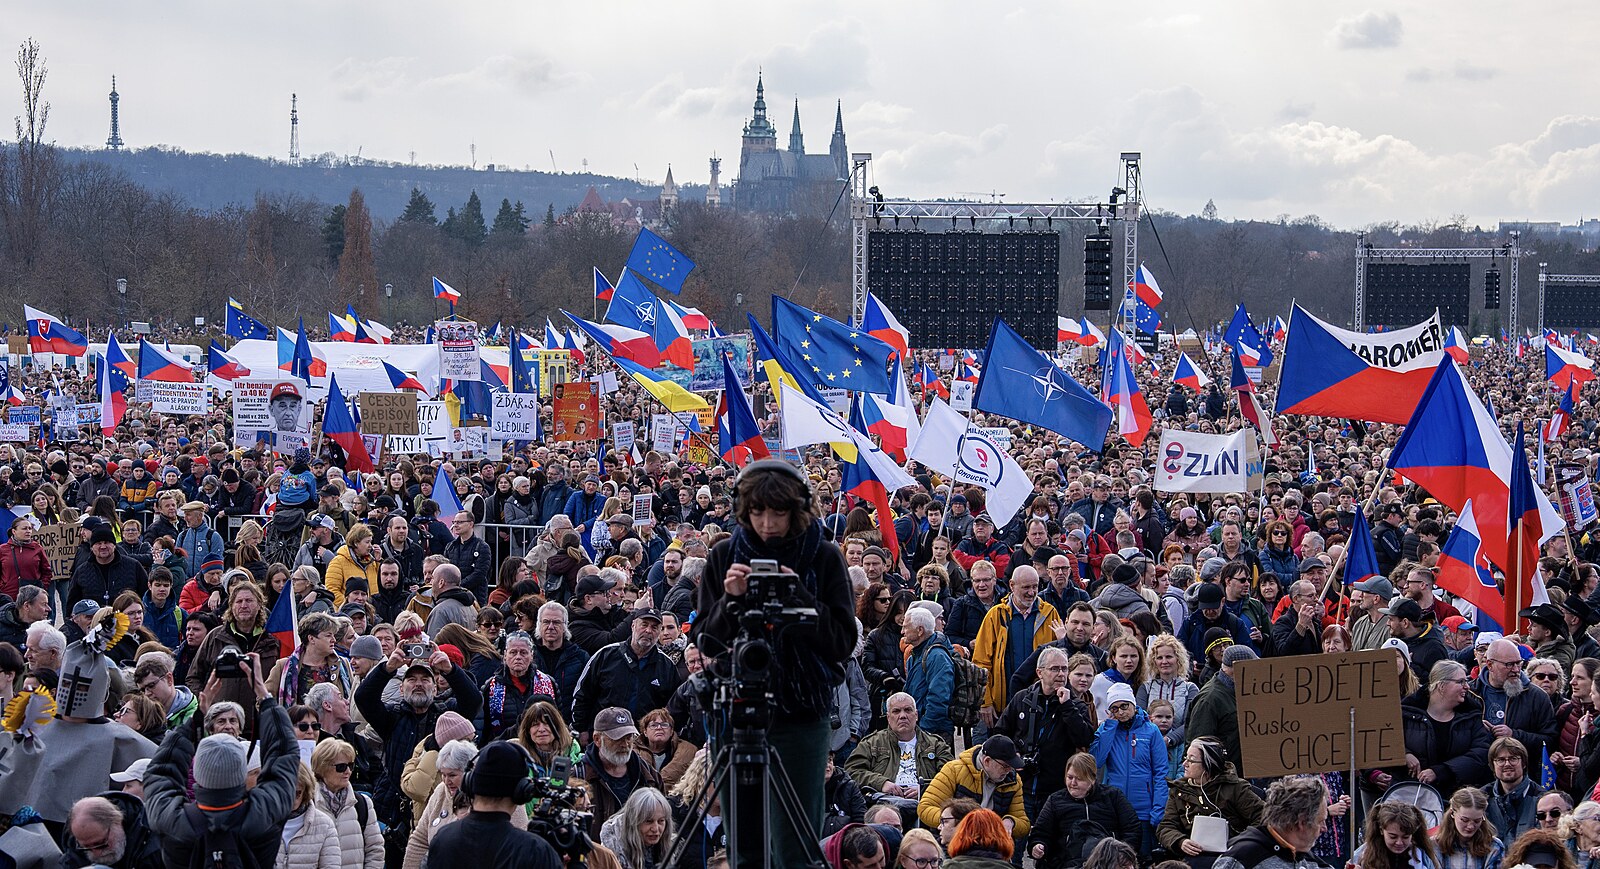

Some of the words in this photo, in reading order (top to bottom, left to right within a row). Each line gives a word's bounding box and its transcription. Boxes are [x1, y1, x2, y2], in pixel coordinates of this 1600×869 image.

[368, 393, 406, 406] ČESKO
[362, 407, 414, 420] BABIŠOVI
[508, 409, 521, 418] VÁS
[363, 421, 414, 434] NEPATŘÍ
[495, 421, 530, 433] SLEDUJE
[1184, 447, 1239, 477] ZLÍN
[1241, 664, 1285, 696] Lidé
[1295, 658, 1388, 705] BDĚTE
[1244, 708, 1300, 737] Rusko
[1280, 732, 1346, 770] CHCE
[1358, 723, 1394, 763] TĚ
